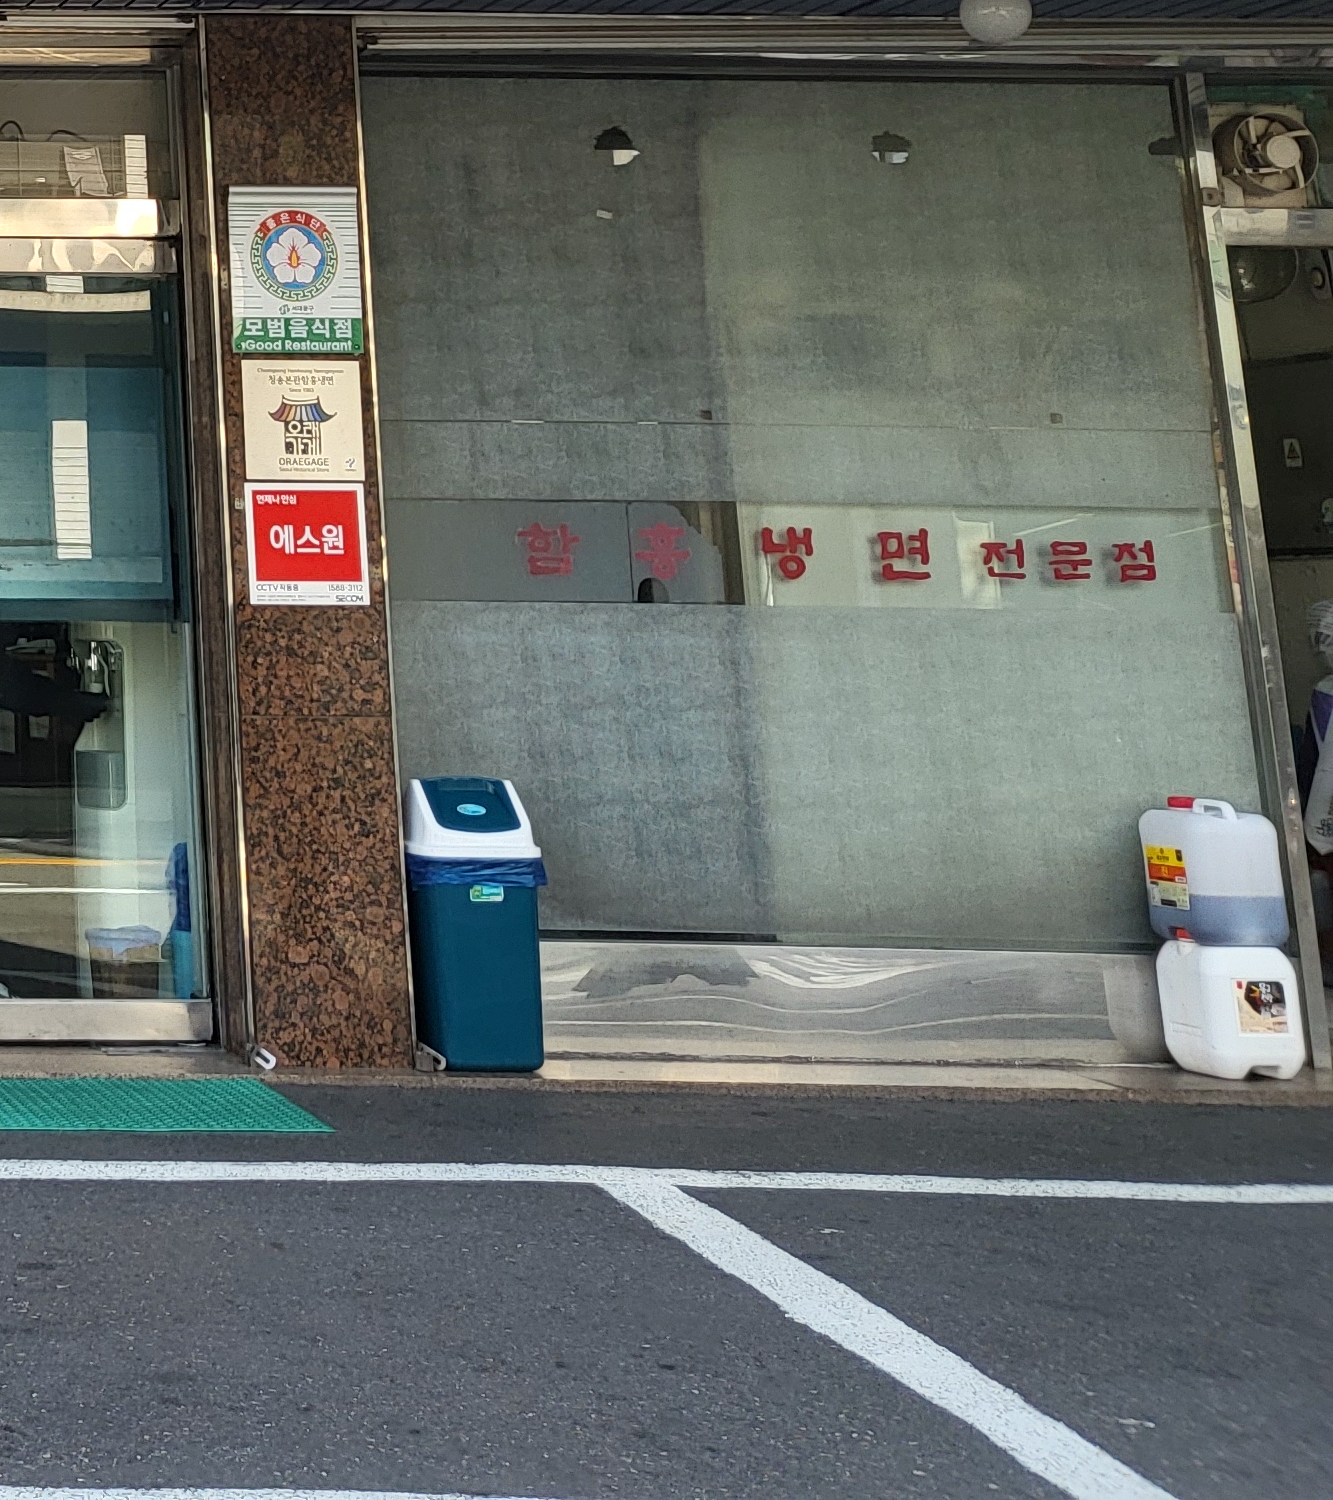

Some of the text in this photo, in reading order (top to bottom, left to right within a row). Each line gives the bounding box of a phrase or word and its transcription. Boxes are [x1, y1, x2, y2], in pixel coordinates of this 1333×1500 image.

[243, 318, 353, 339] 모범음식점
[244, 340, 353, 352] Good Restaurant
[278, 457, 330, 466] ORAEGAGE
[281, 494, 297, 505] 안심
[269, 524, 345, 555] 에스원
[516, 521, 1159, 584] 함흥냉면 전문점
[256, 583, 279, 592] CCTV
[328, 584, 364, 592] 1588-3112
[335, 594, 364, 602] SECOM
